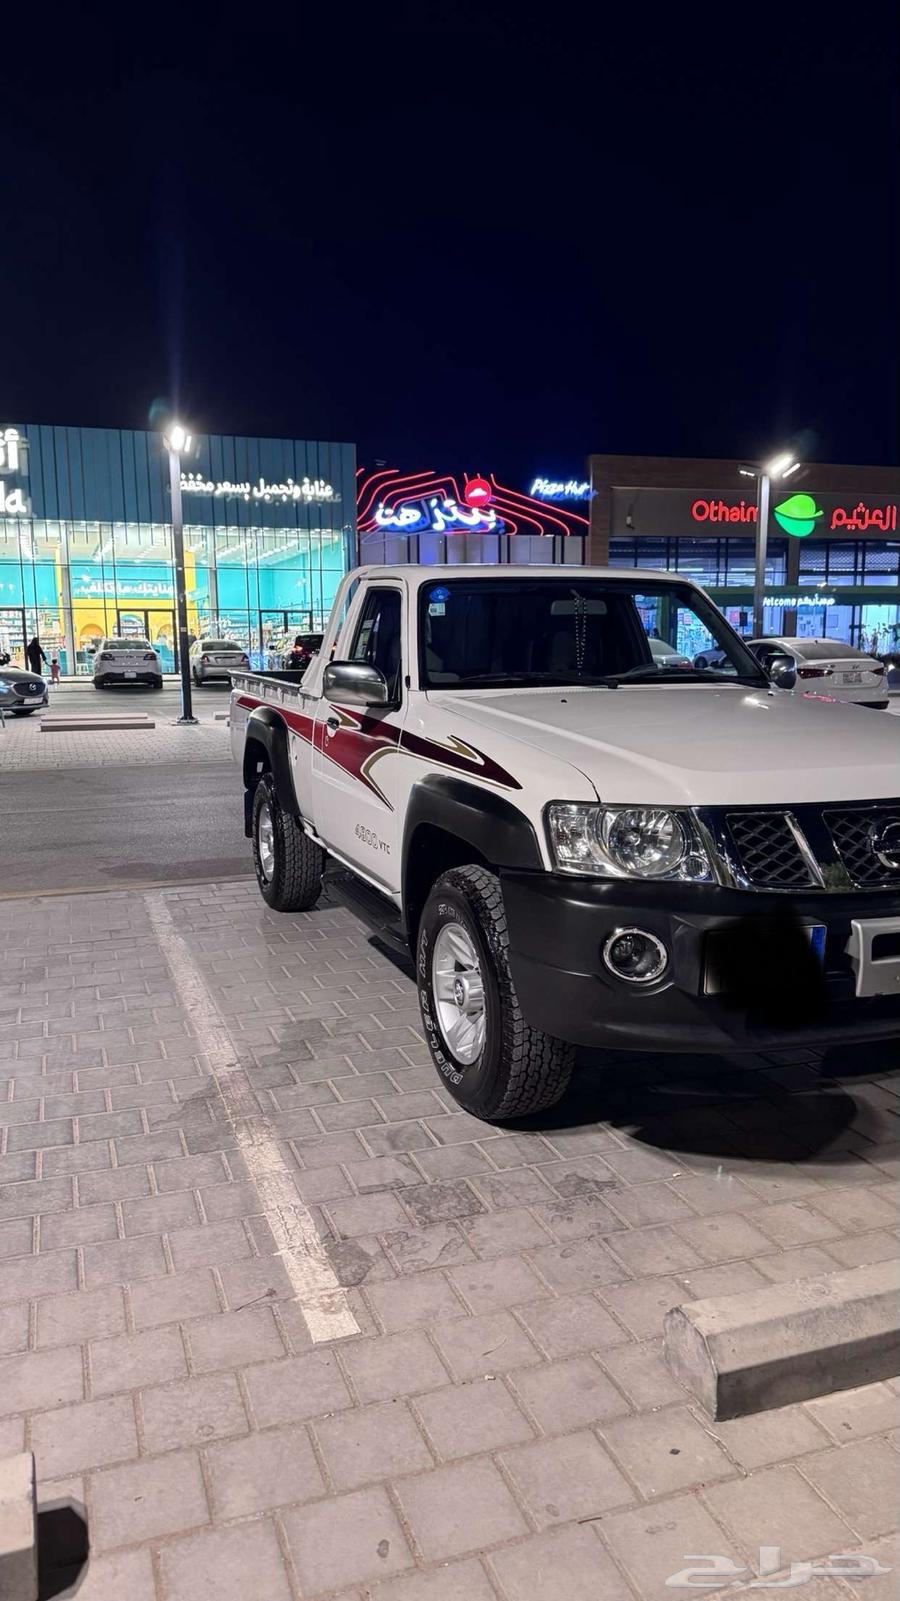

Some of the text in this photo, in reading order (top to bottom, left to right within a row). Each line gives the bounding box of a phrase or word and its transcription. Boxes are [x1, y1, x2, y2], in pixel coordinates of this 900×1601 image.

[215, 481, 250, 501] بسعر
[530, 478, 590, 496] Pizza Hut
[831, 502, 897, 530] العثيم
[762, 597, 796, 607] elcome
[378, 840, 390, 855] VTC
